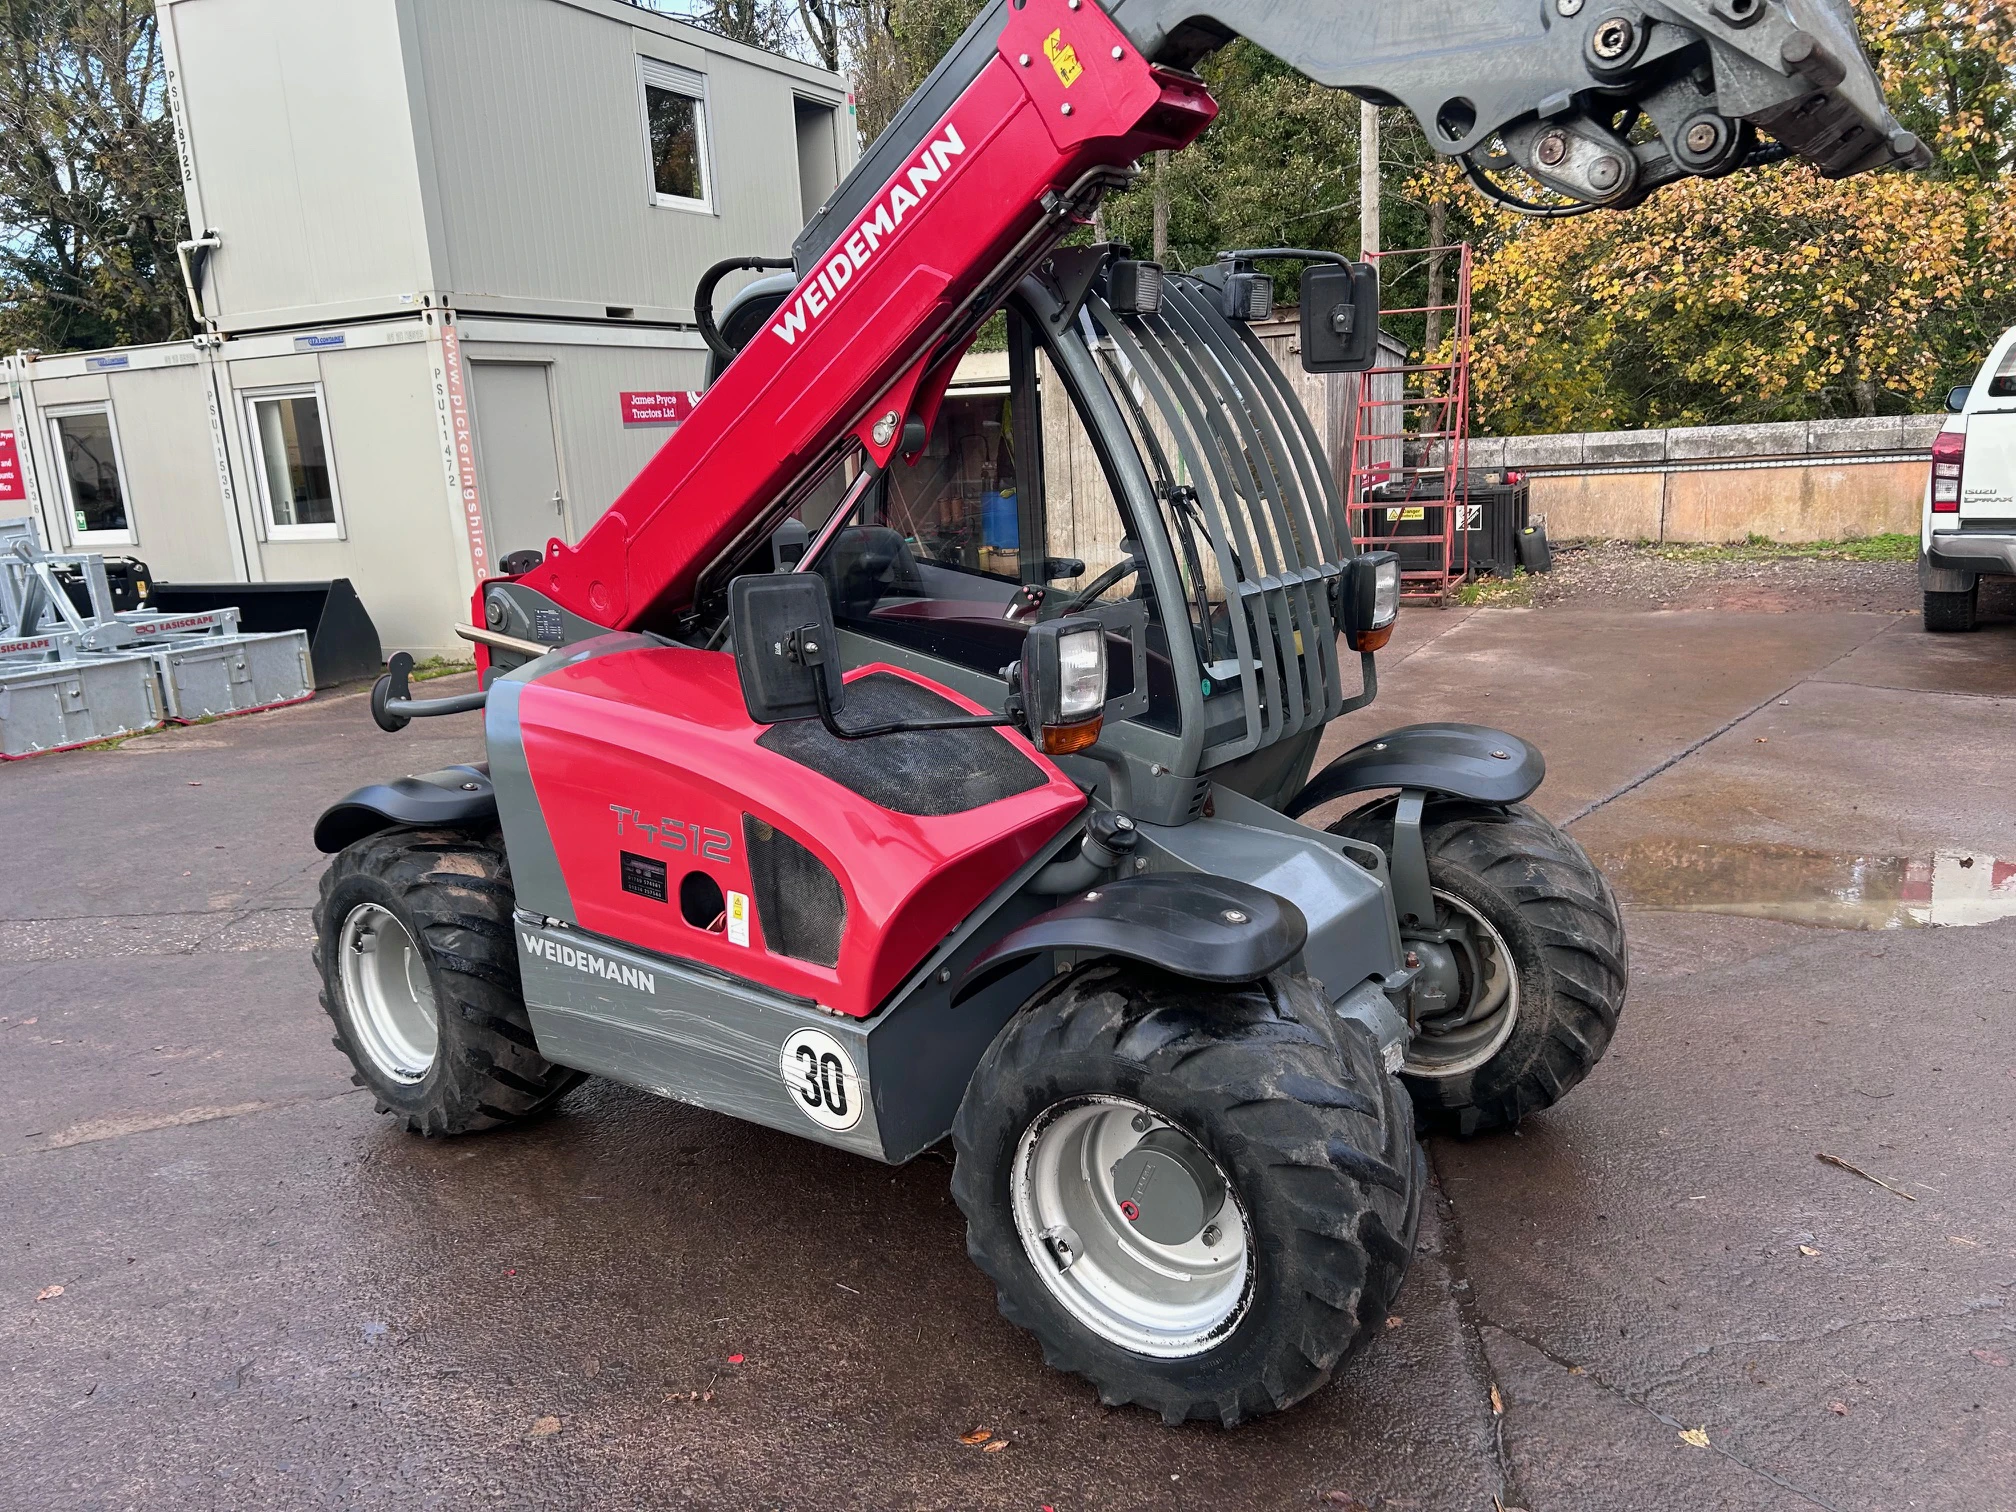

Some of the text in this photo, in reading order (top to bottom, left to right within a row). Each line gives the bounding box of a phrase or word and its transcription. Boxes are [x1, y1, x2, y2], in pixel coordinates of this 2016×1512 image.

[771, 122, 967, 345] WEIDEMANN
[434, 368, 455, 486] PSU11472
[631, 395, 677, 406] James Pryce
[632, 408, 675, 418] Tractors Ltd
[207, 391, 231, 499] PSU11535
[160, 615, 214, 631] EASISCRAPE
[610, 804, 732, 863] T4512
[521, 932, 655, 995] WEIDEMANN
[796, 1045, 847, 1116] 30
